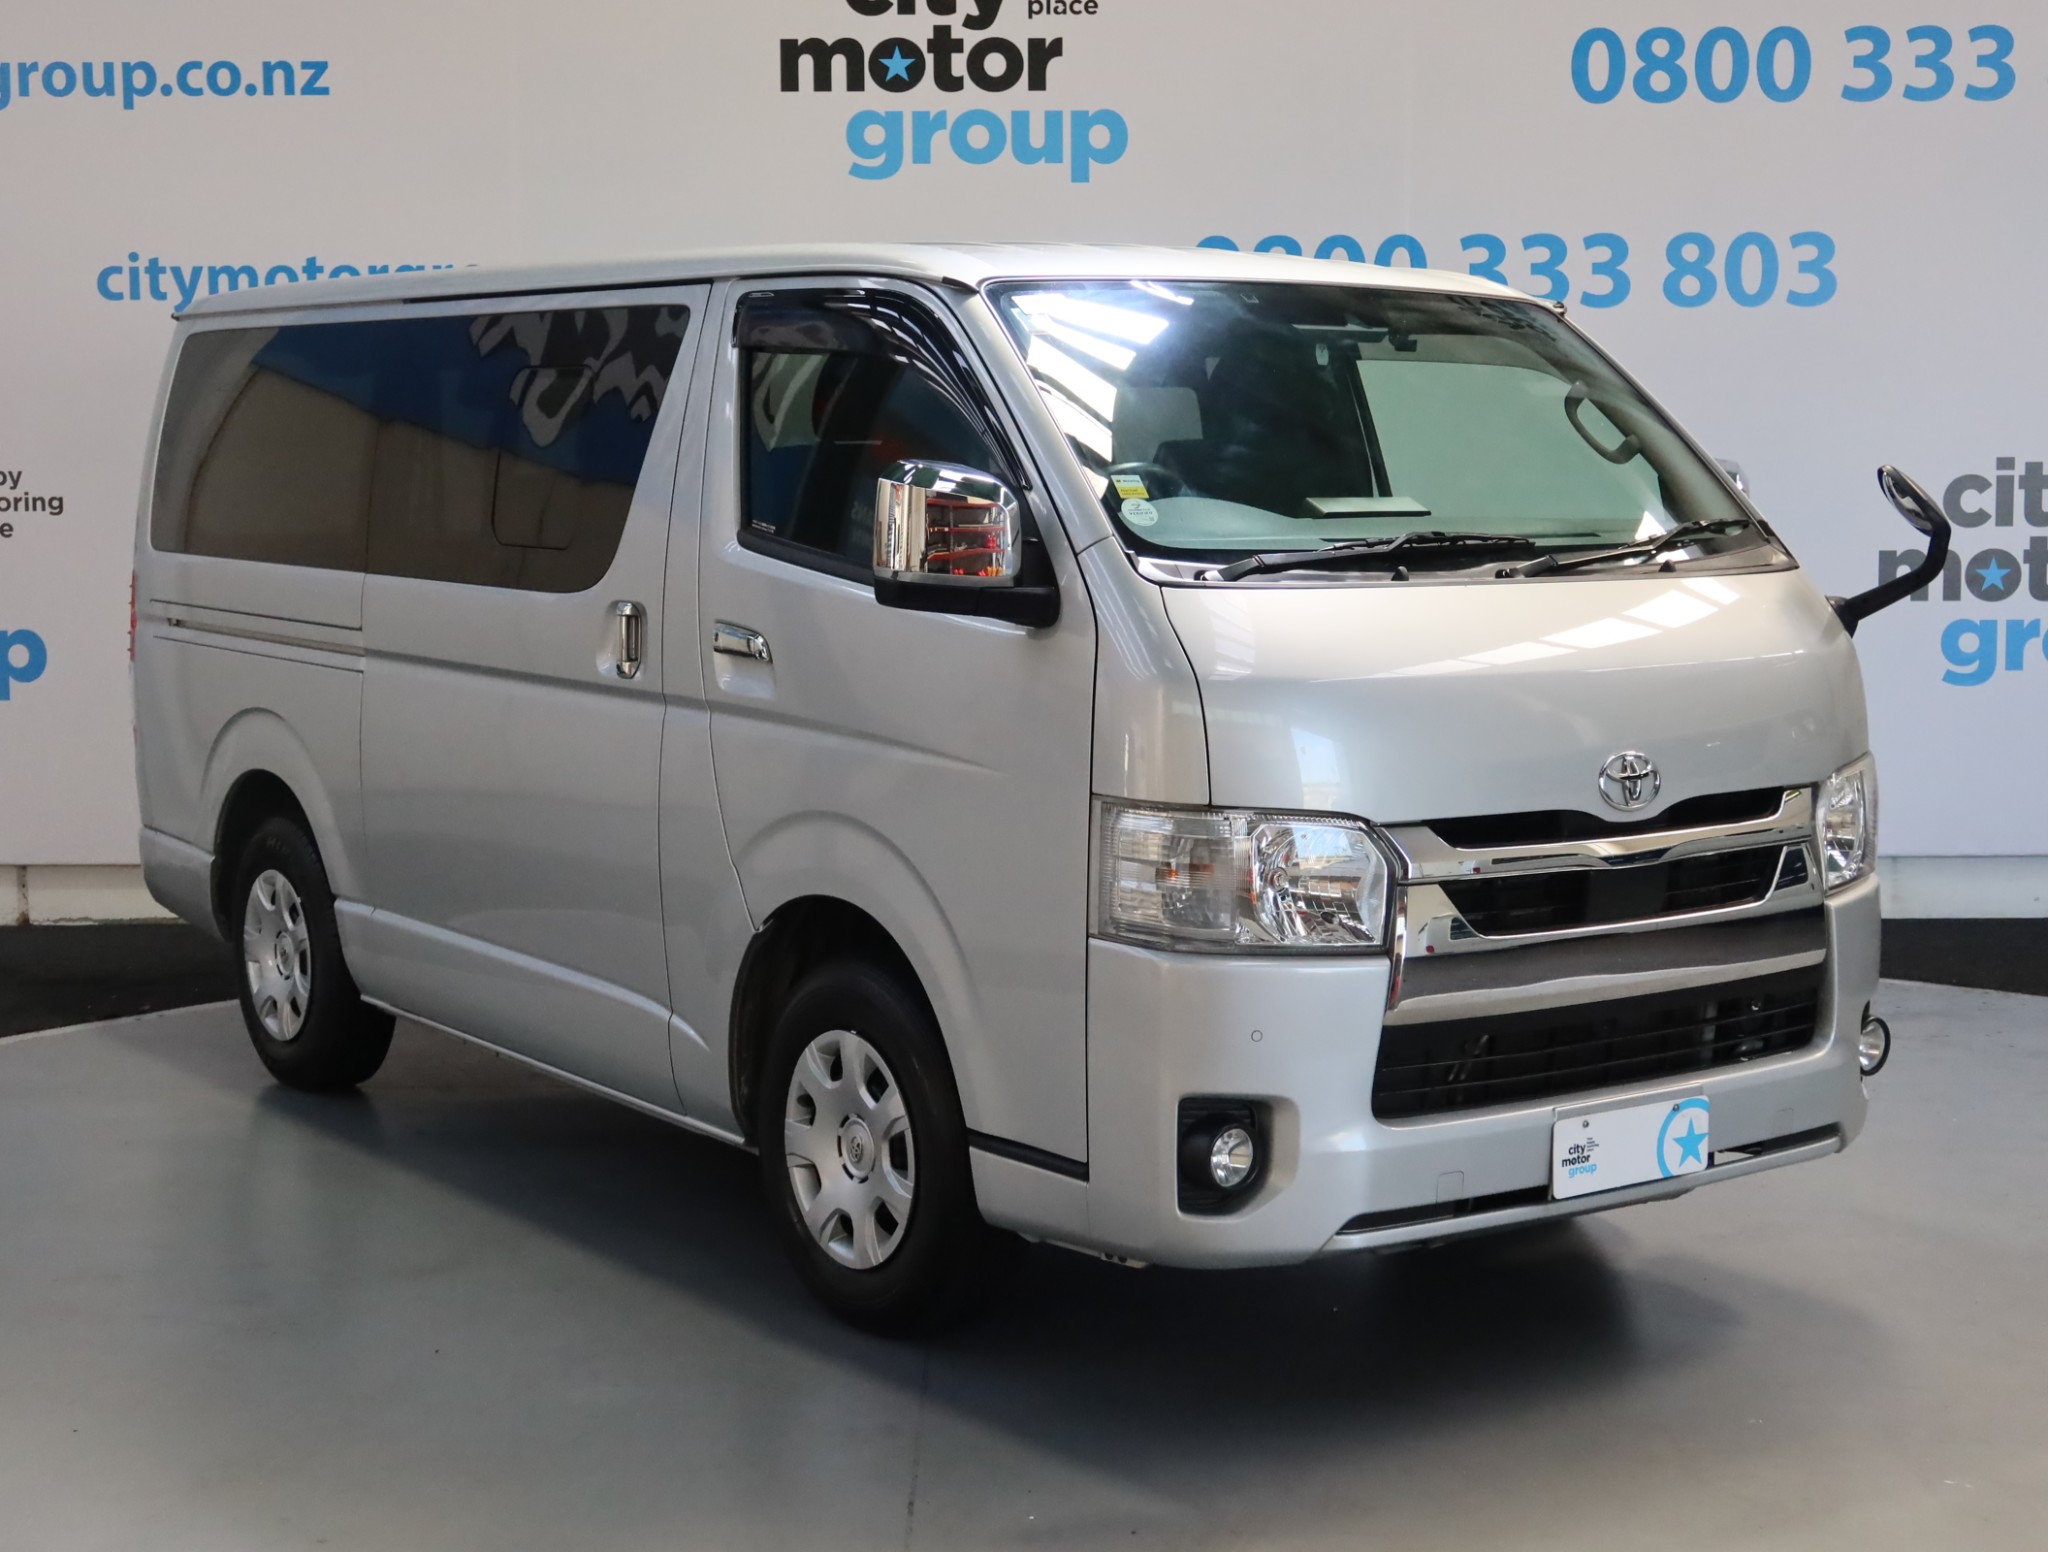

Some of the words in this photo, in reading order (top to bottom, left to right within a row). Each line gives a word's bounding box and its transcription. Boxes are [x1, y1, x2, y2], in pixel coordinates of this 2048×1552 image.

[1028, 0, 1098, 19] place
[780, 24, 1063, 93] motor
[1571, 26, 1812, 104] 0800
[1841, 25, 2016, 102] 333
[846, 108, 1129, 183] group
[1663, 231, 1838, 308] 803
[1943, 457, 2048, 528] cit
[1941, 618, 2048, 687] gr
[1562, 1154, 1591, 1167] motor
[1568, 1144, 1586, 1155] city
[1568, 1164, 1597, 1178] group
